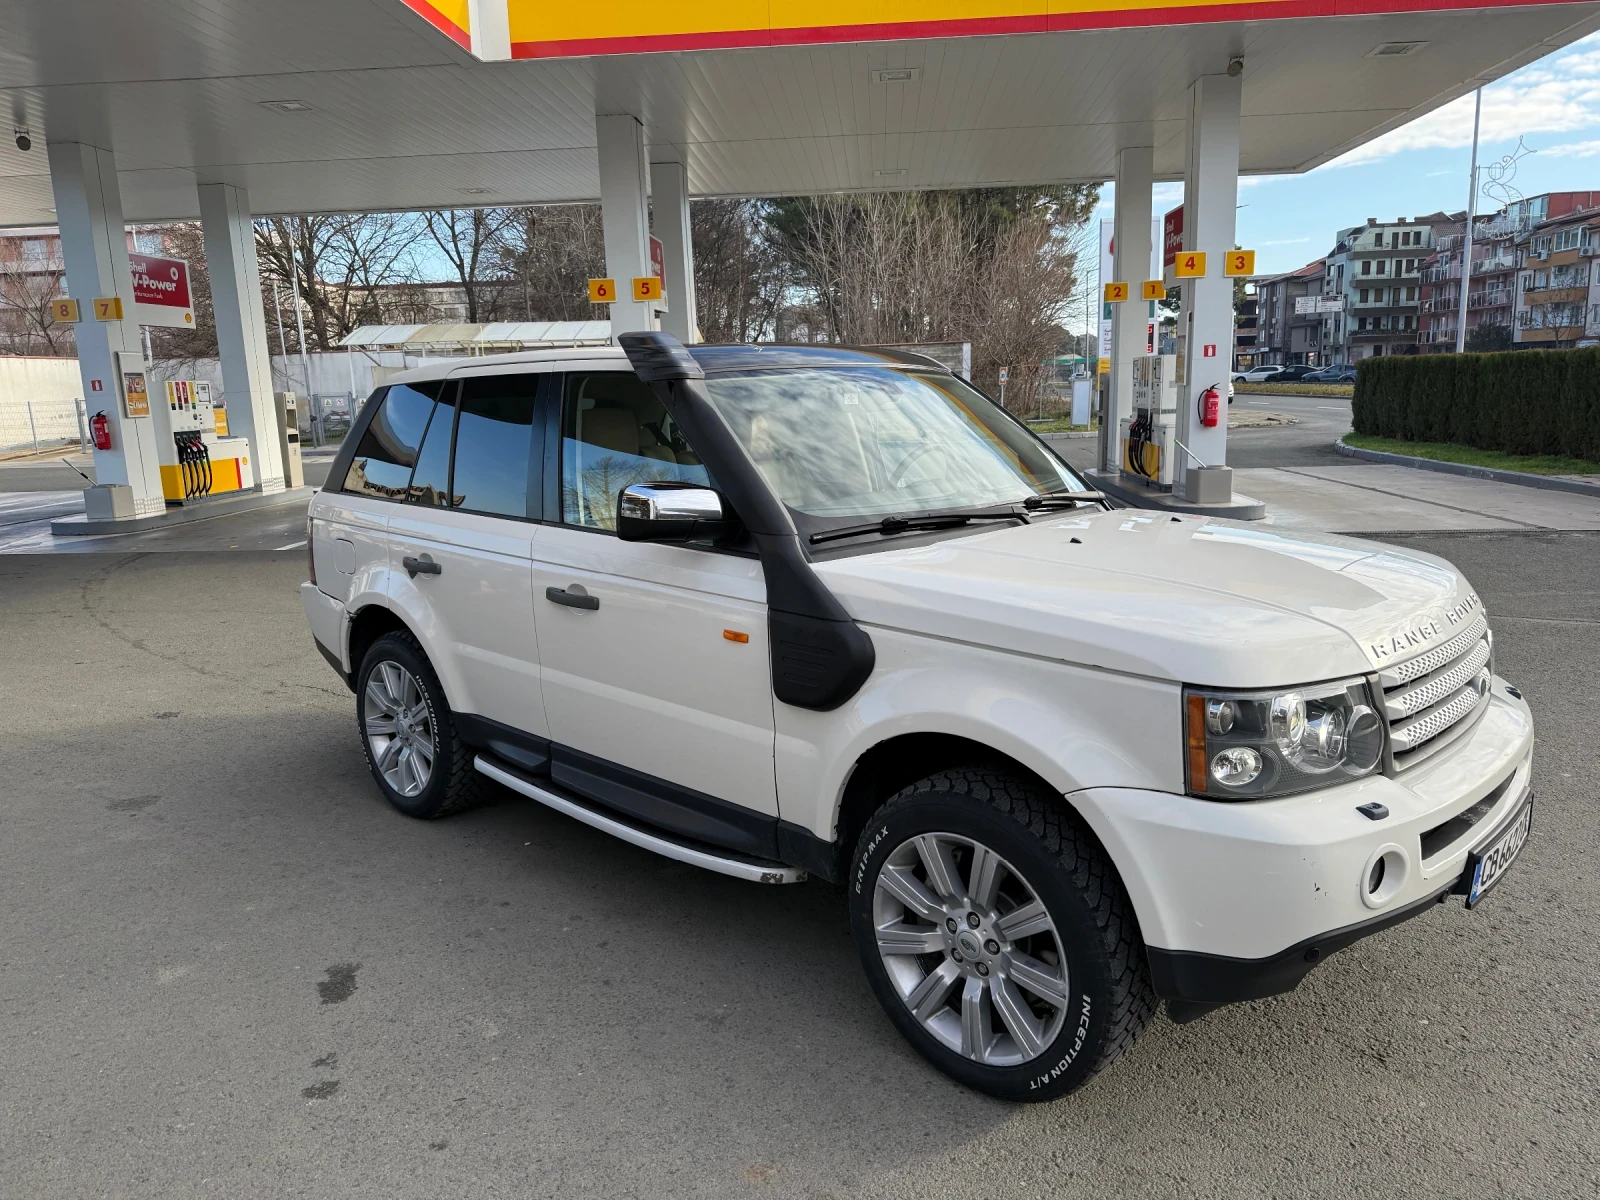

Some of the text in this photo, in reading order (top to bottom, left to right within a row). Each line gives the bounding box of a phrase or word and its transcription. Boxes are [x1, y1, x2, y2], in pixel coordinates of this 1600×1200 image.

[1185, 256, 1196, 270] 4
[1234, 256, 1245, 270] 3
[132, 273, 176, 292] V-Power
[641, 282, 650, 295] 5
[597, 284, 606, 296] 6
[1113, 286, 1121, 297] 2
[1150, 285, 1155, 295] 1
[59, 304, 70, 317] 8
[100, 303, 109, 316] 7
[1371, 592, 1478, 658] RANGE ROVER
[416, 675, 438, 734] INCEPTION
[855, 826, 889, 894] GRIPMAX
[1030, 994, 1091, 1090] INCEPTION A/T
